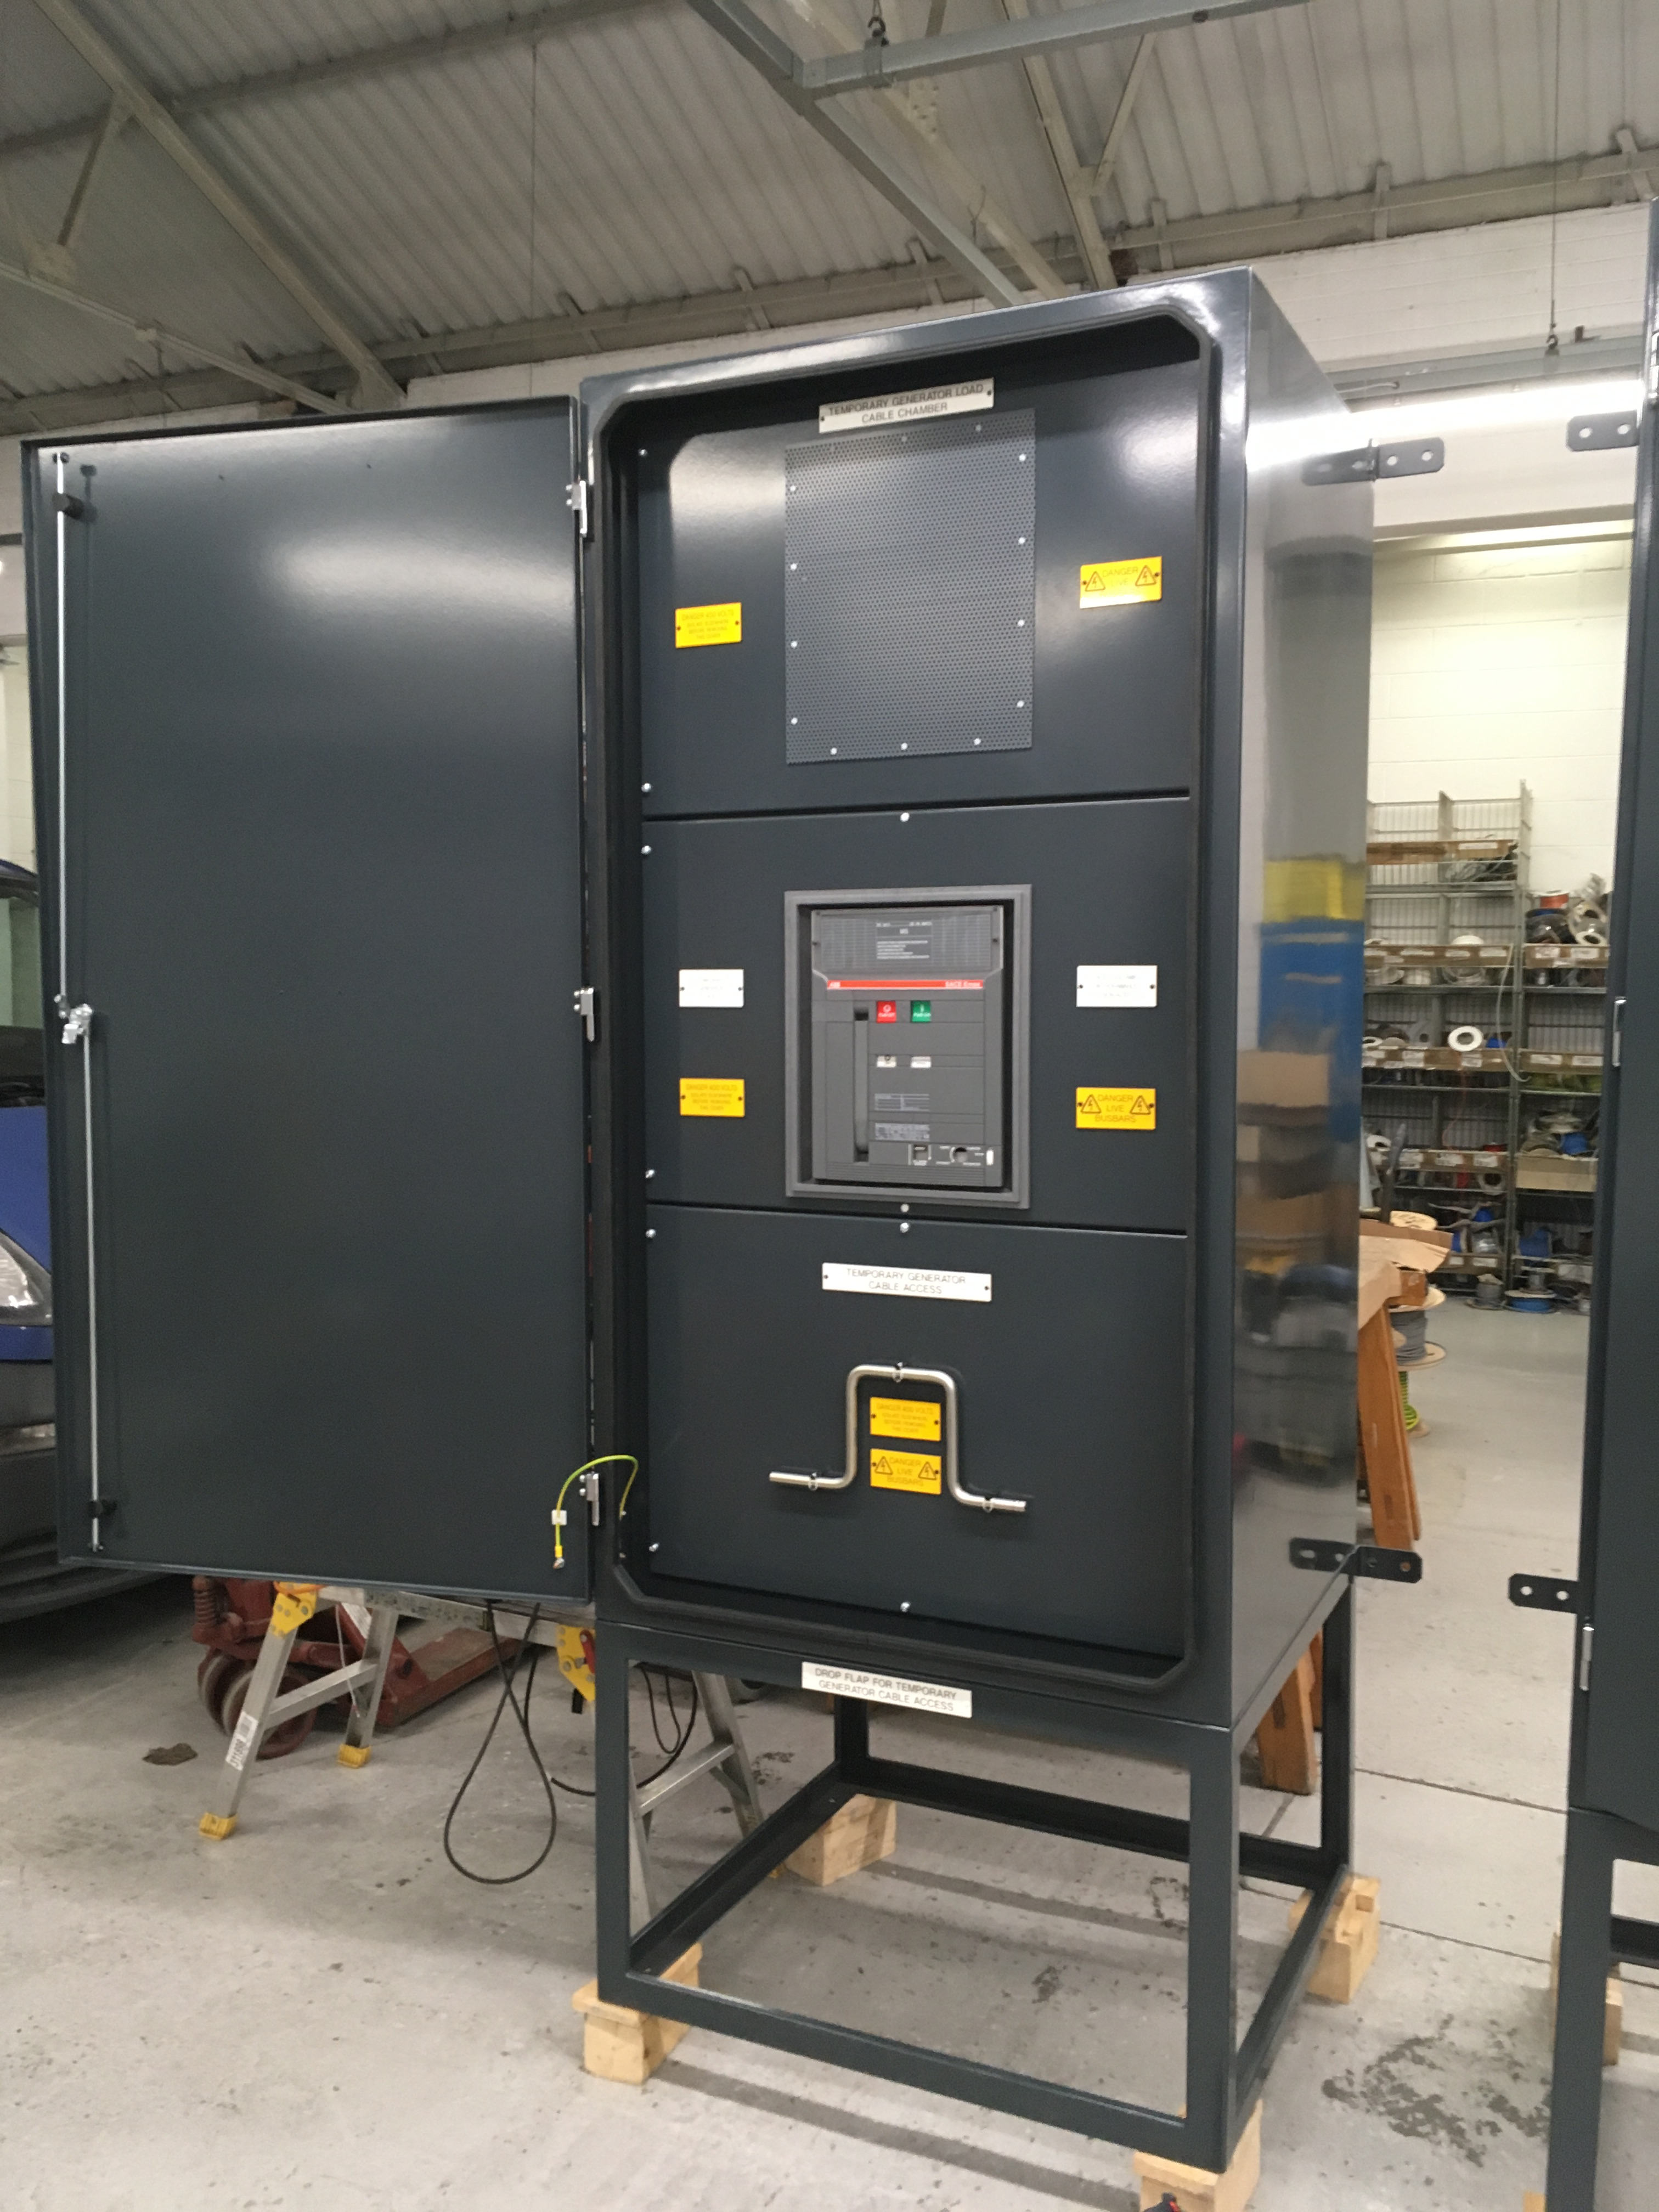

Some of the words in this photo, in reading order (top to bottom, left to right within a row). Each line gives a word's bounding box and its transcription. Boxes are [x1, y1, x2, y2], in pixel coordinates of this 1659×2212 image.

[828, 399, 889, 415] TEMPORARY
[892, 388, 952, 406] GENERATOR
[955, 383, 984, 396] LOAD
[861, 409, 894, 422] CABLE
[898, 402, 947, 417] CHAMBER
[1102, 566, 1138, 578] DANGER
[1095, 1114, 1136, 1122] BUSBARS
[847, 1268, 904, 1279] TEMPORARY
[908, 1272, 966, 1284] GENERATOR
[868, 1281, 899, 1291] CABLE
[904, 1284, 942, 1294] ACCESS
[889, 1457, 921, 1466] DANGER
[887, 1477, 924, 1486] BUSBARS
[815, 1668, 842, 1679] DROP
[845, 1673, 869, 1684] FLAP
[873, 1678, 893, 1688] FOR
[896, 1681, 957, 1700] TEMPORARY
[819, 1680, 875, 1696] GENERATOR
[878, 1690, 910, 1703] CABLE
[914, 1697, 954, 1711] ACCESS
